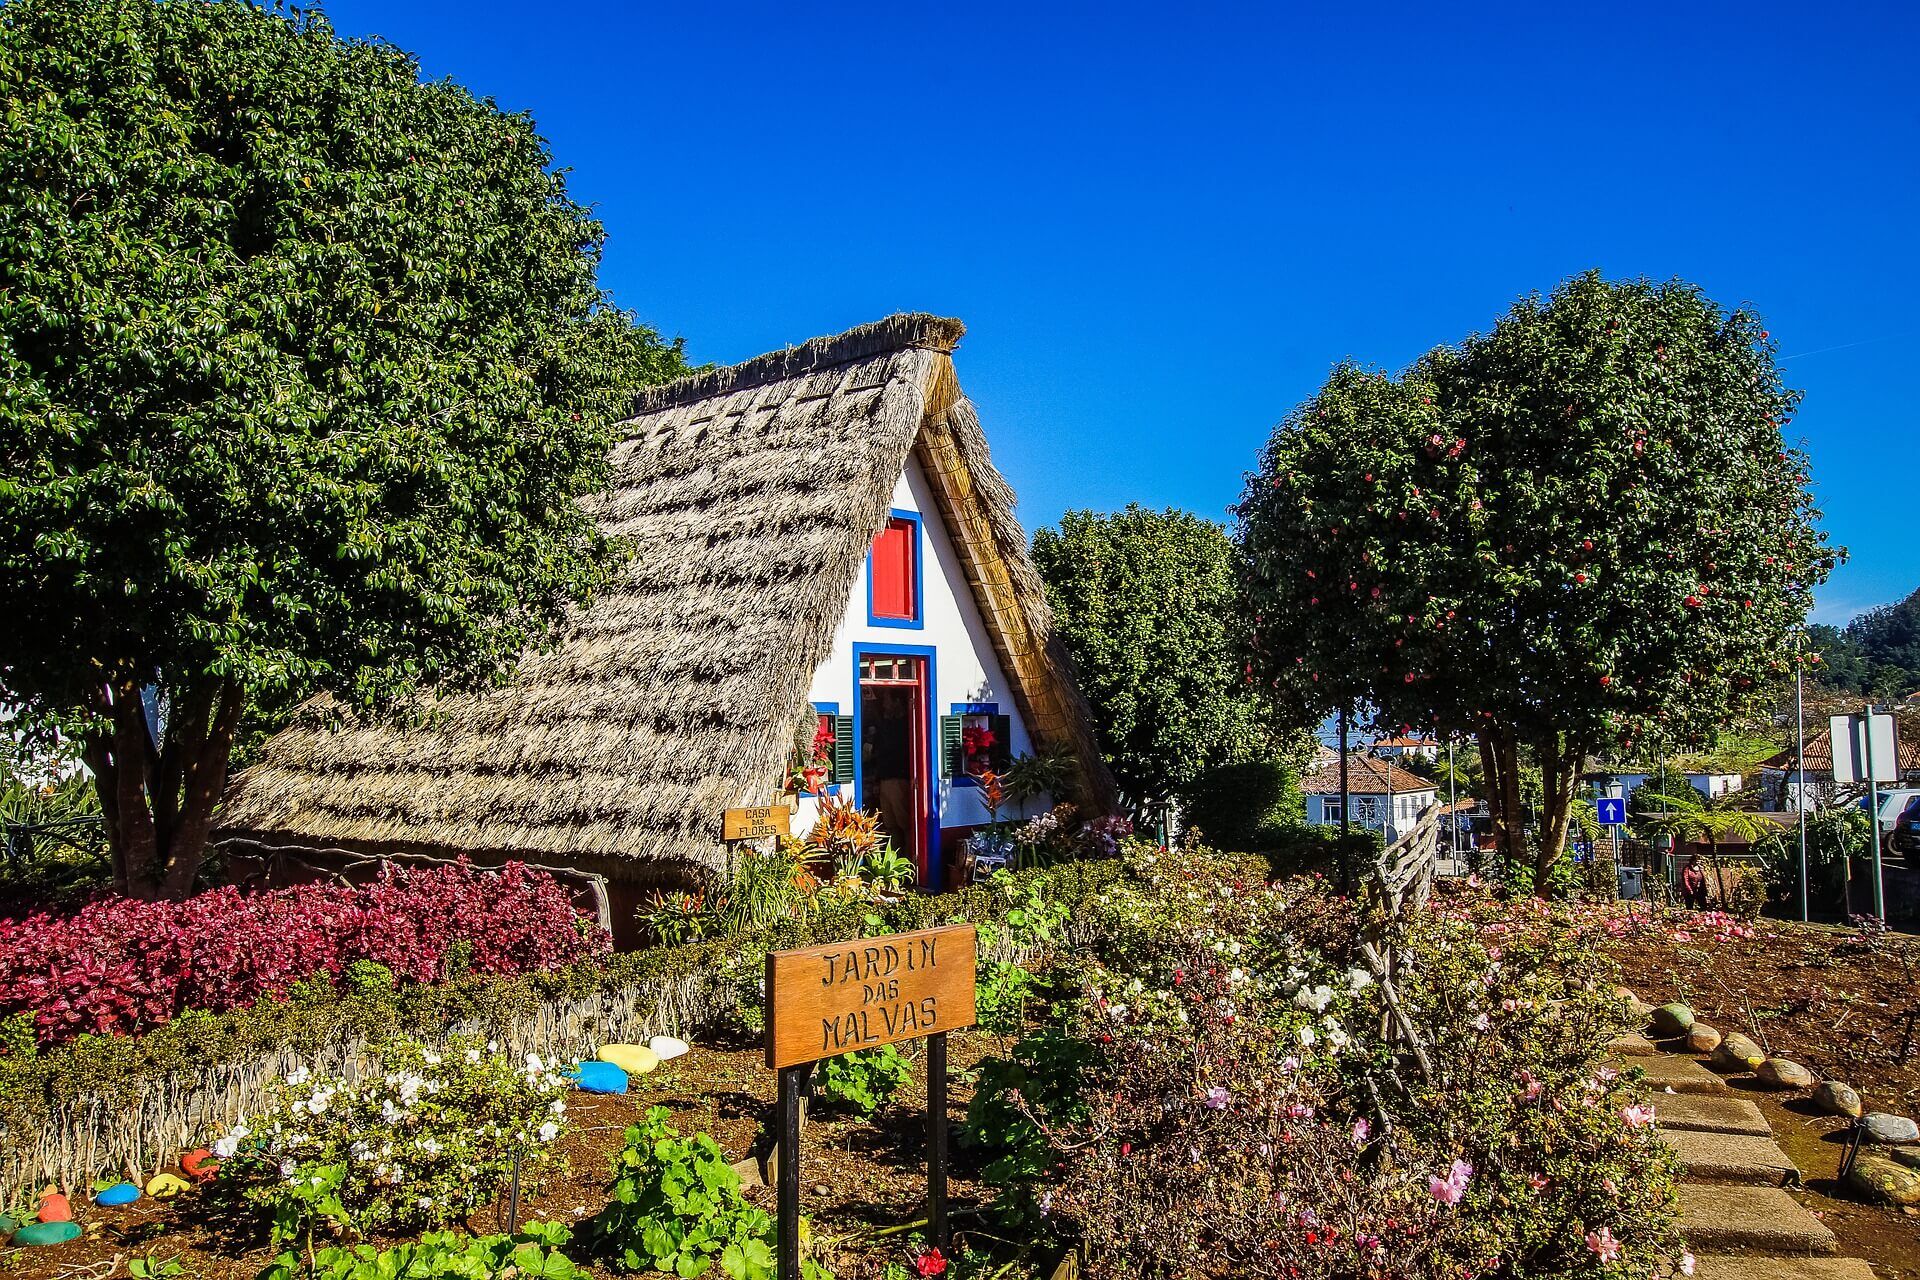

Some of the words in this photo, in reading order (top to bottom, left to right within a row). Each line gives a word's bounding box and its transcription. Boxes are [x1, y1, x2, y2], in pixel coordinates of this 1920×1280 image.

[745, 808, 771, 819] CASA
[752, 818, 765, 826] DAS
[739, 824, 777, 837] FLORES
[863, 979, 899, 1005] DAS
[821, 997, 937, 1051] MALVAS
